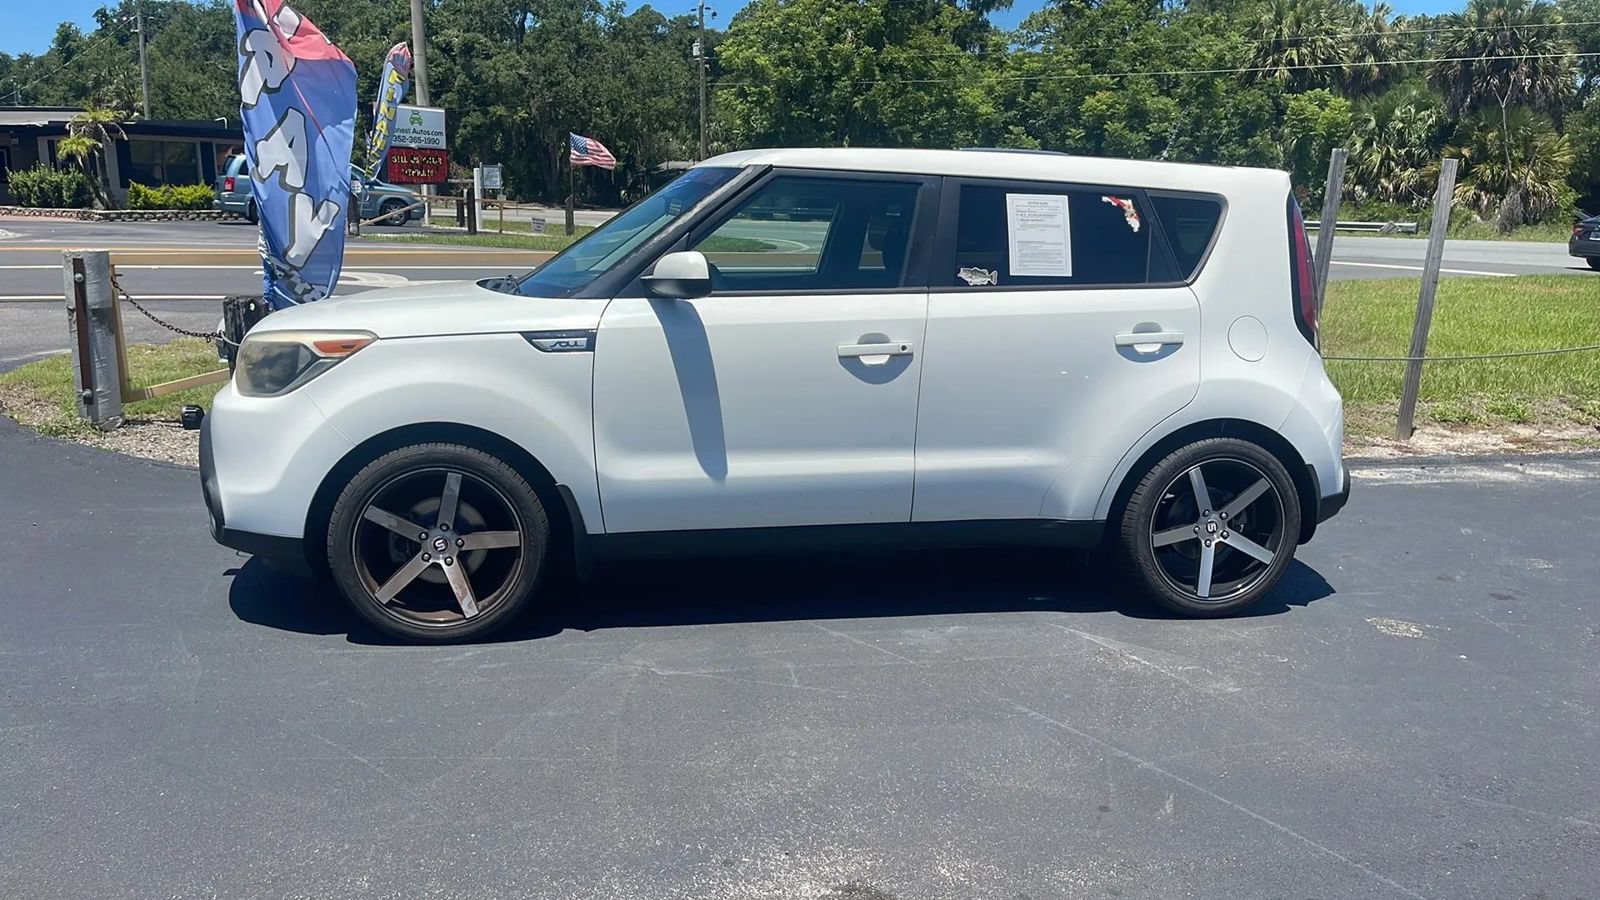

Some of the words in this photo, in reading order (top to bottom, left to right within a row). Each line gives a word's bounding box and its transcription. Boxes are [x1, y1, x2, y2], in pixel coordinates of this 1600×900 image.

[412, 127, 444, 136] Autos.com
[392, 134, 440, 145] 352-365-1990
[239, 28, 340, 268] PAY
